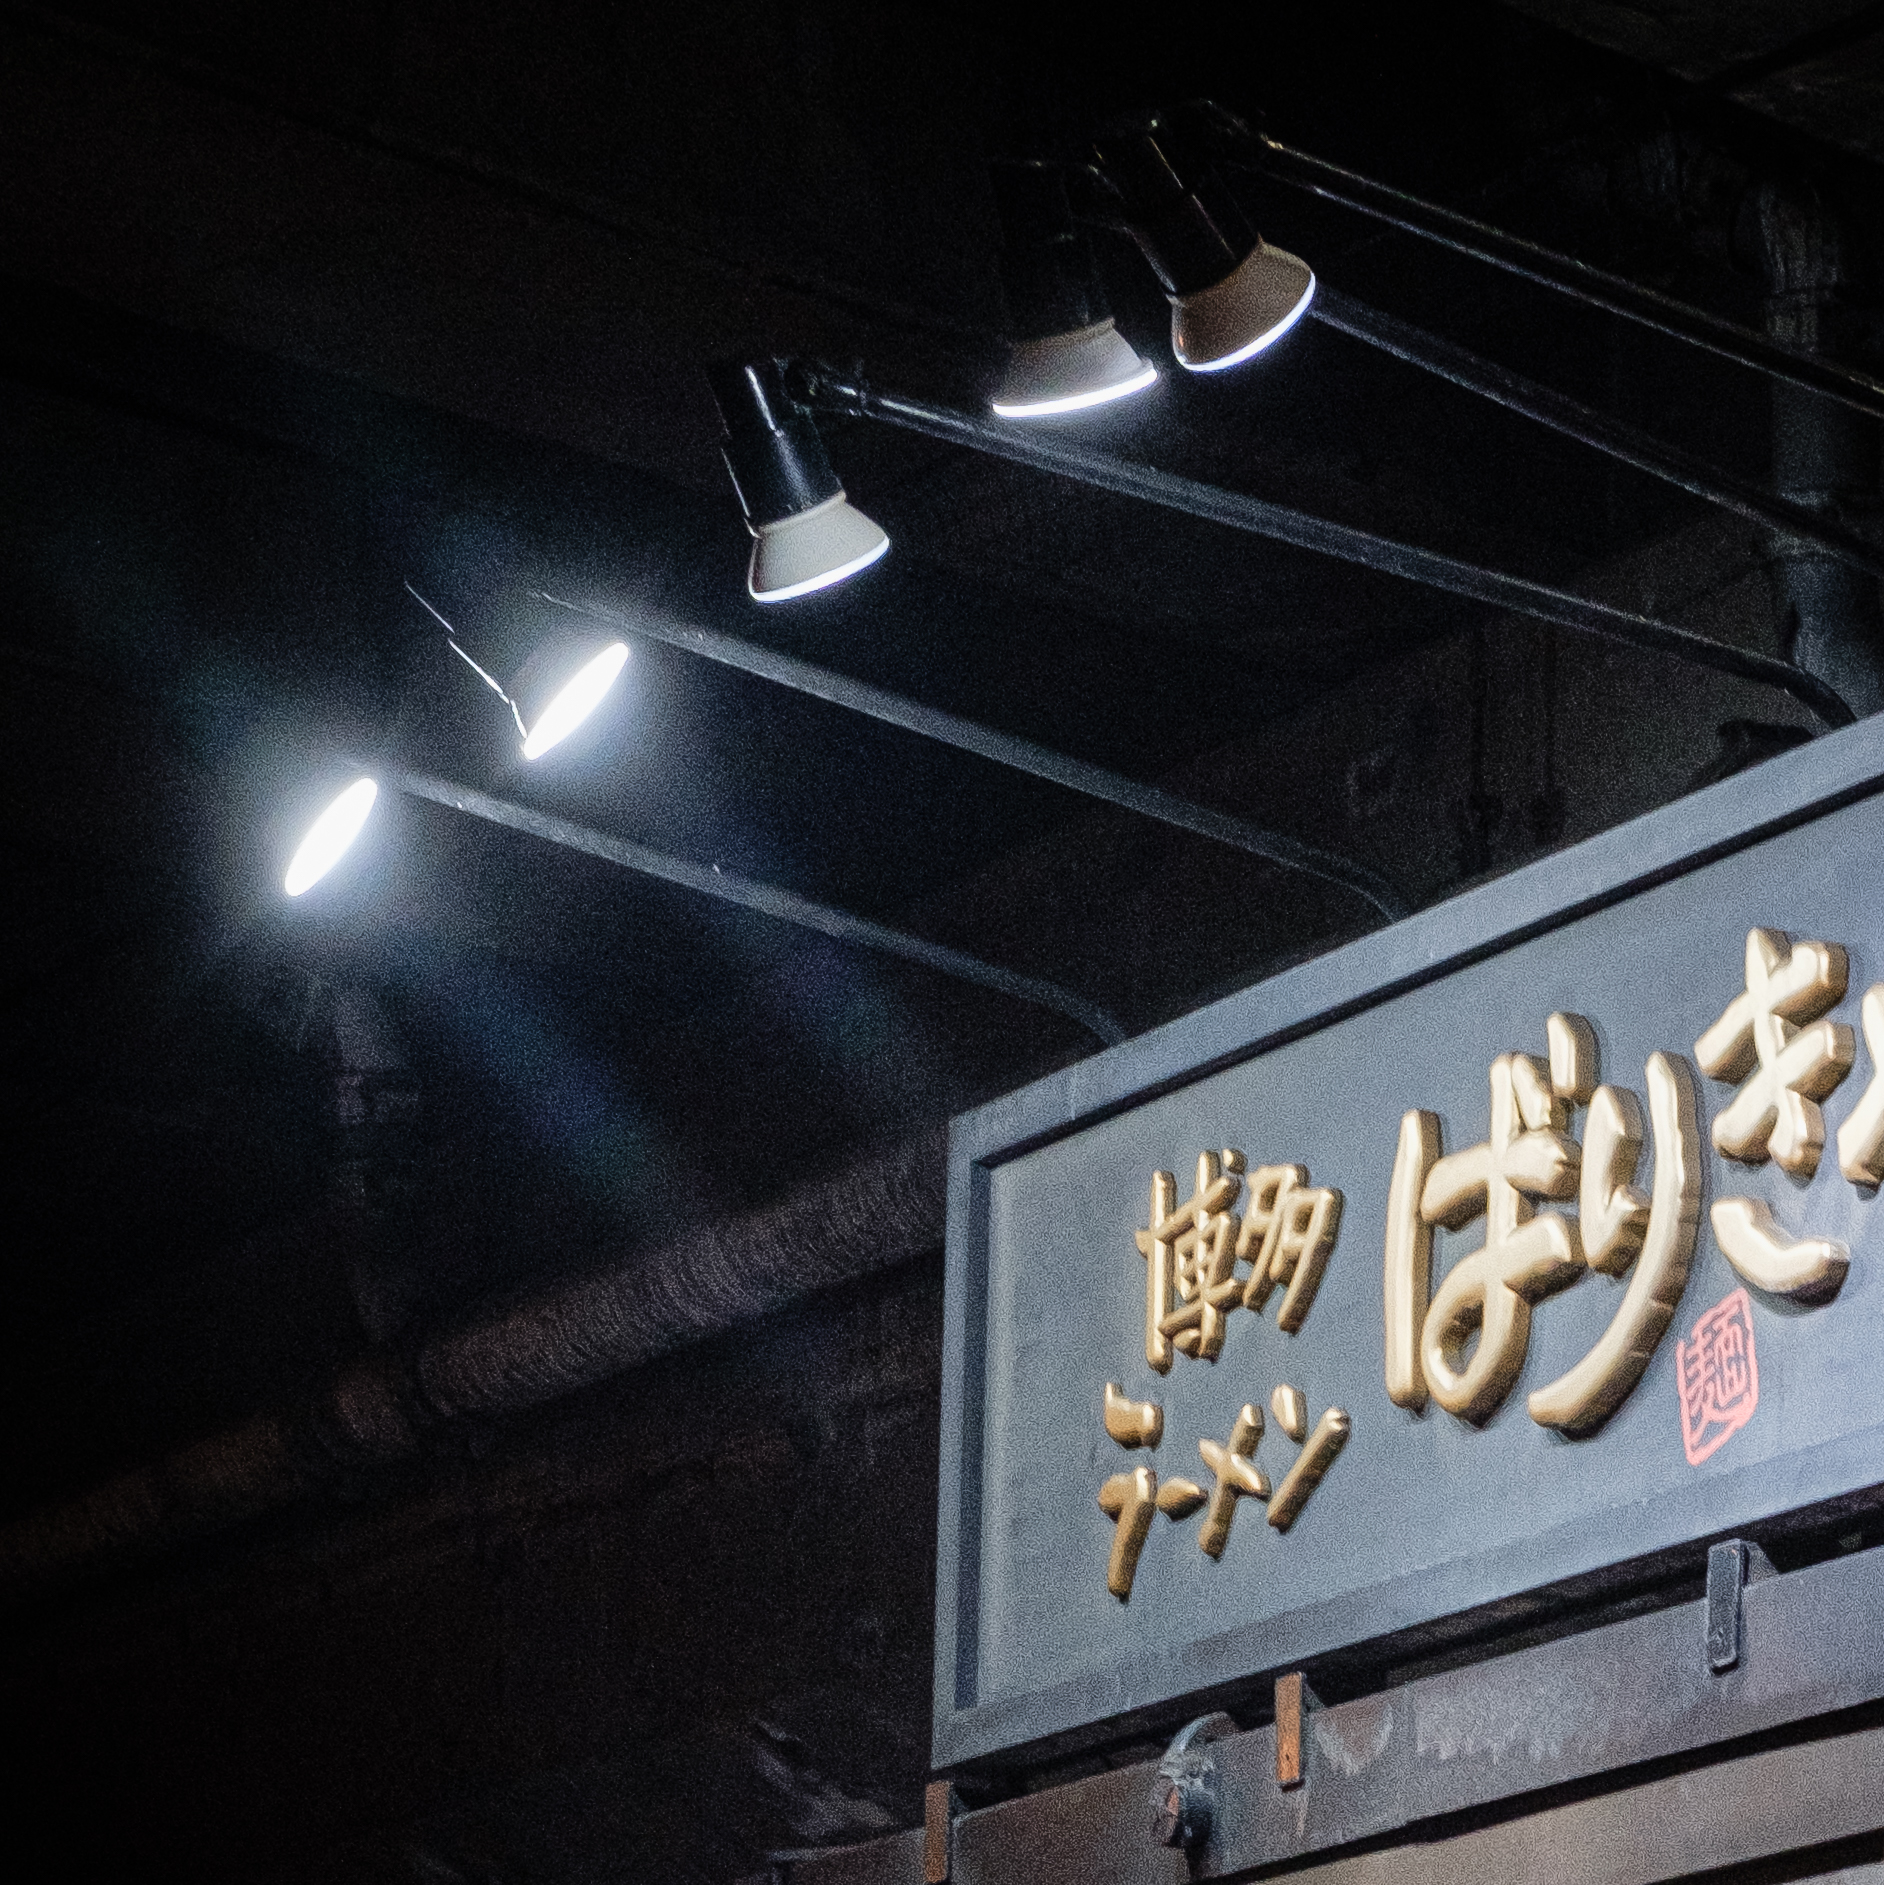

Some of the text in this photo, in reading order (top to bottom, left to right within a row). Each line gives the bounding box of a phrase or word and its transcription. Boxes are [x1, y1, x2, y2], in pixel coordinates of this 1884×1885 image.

[1135, 1147, 1346, 1374] 博多
[1097, 1381, 1352, 1599] ラーメン
